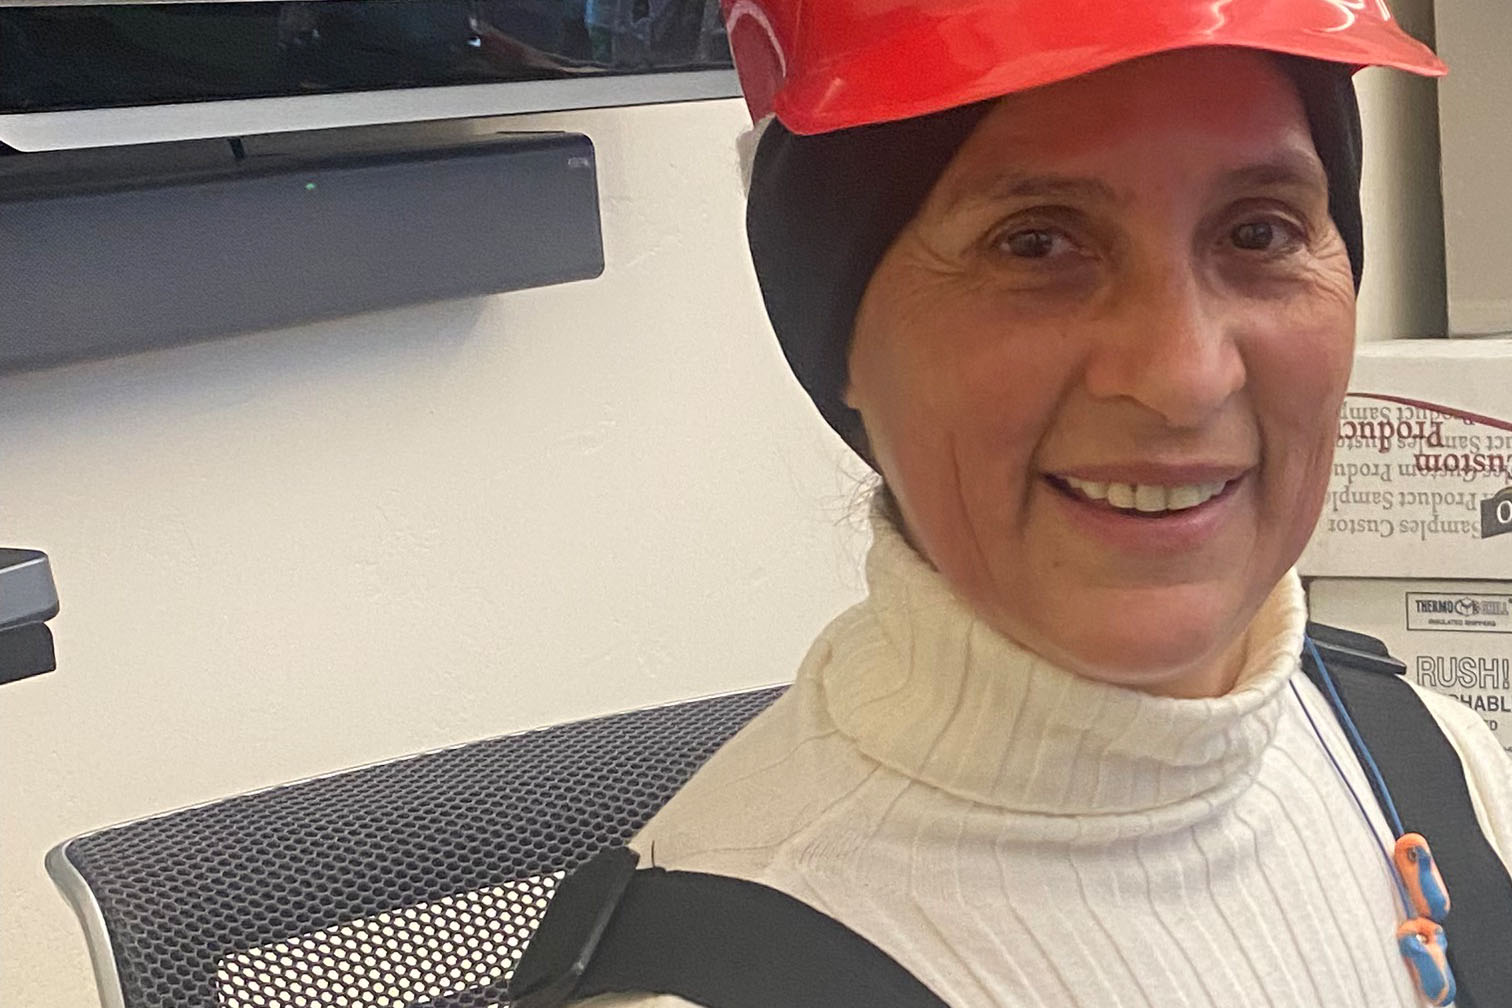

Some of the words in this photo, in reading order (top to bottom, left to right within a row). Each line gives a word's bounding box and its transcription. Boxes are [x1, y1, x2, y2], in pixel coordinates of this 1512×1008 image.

[1398, 491, 1477, 513] Product
[1415, 600, 1454, 613] THERMO
[1417, 655, 1510, 690] RUSH!
